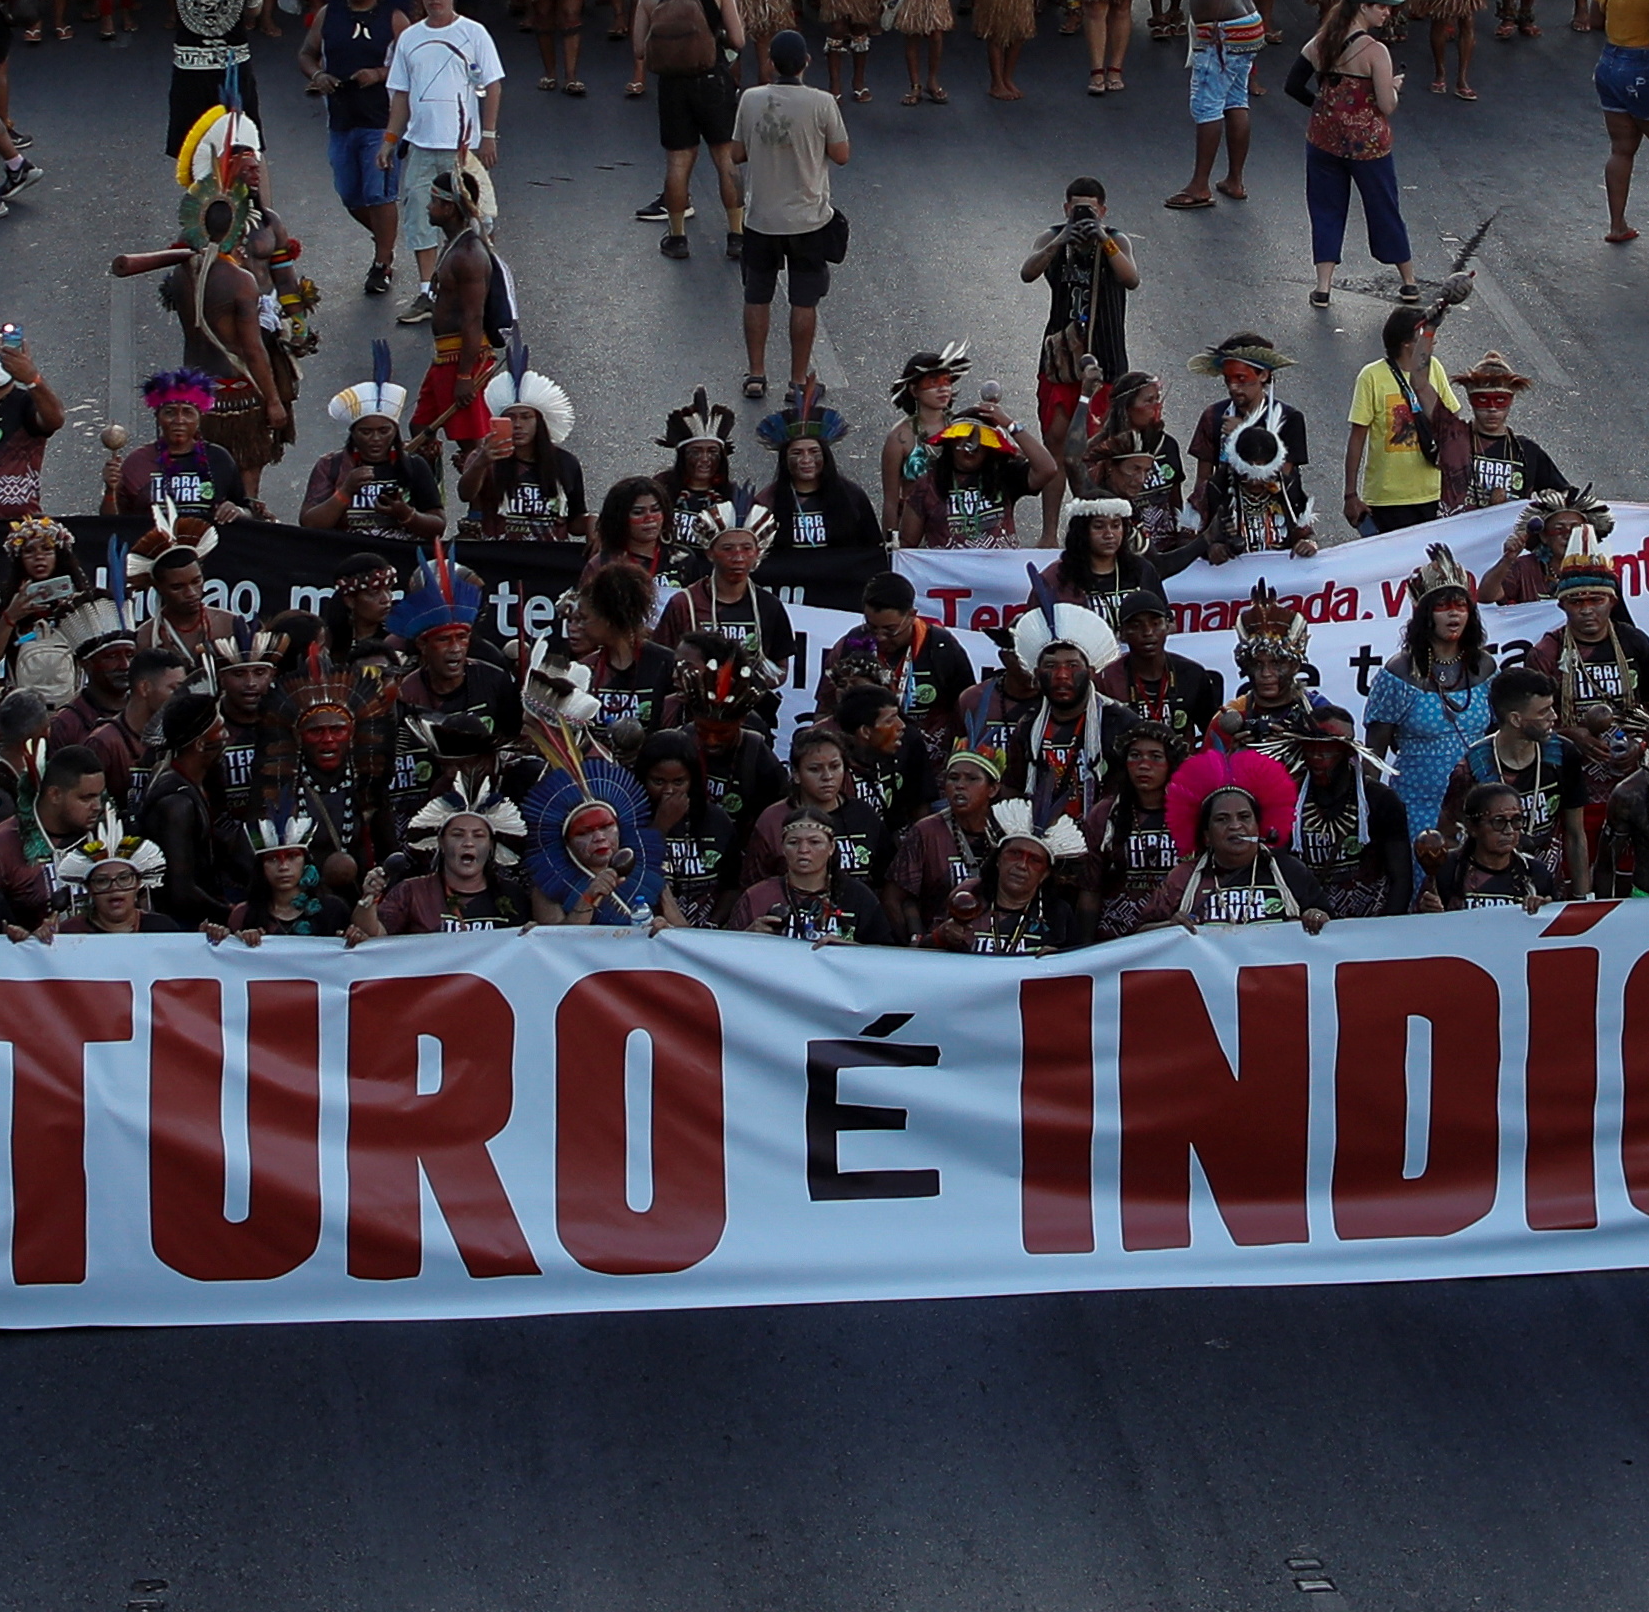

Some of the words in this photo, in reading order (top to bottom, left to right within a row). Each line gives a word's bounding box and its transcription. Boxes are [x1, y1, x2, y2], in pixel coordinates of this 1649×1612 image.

[1210, 889, 1266, 905] TERRA
[1210, 903, 1266, 921] LIVRE
[804, 1011, 943, 1203] É
